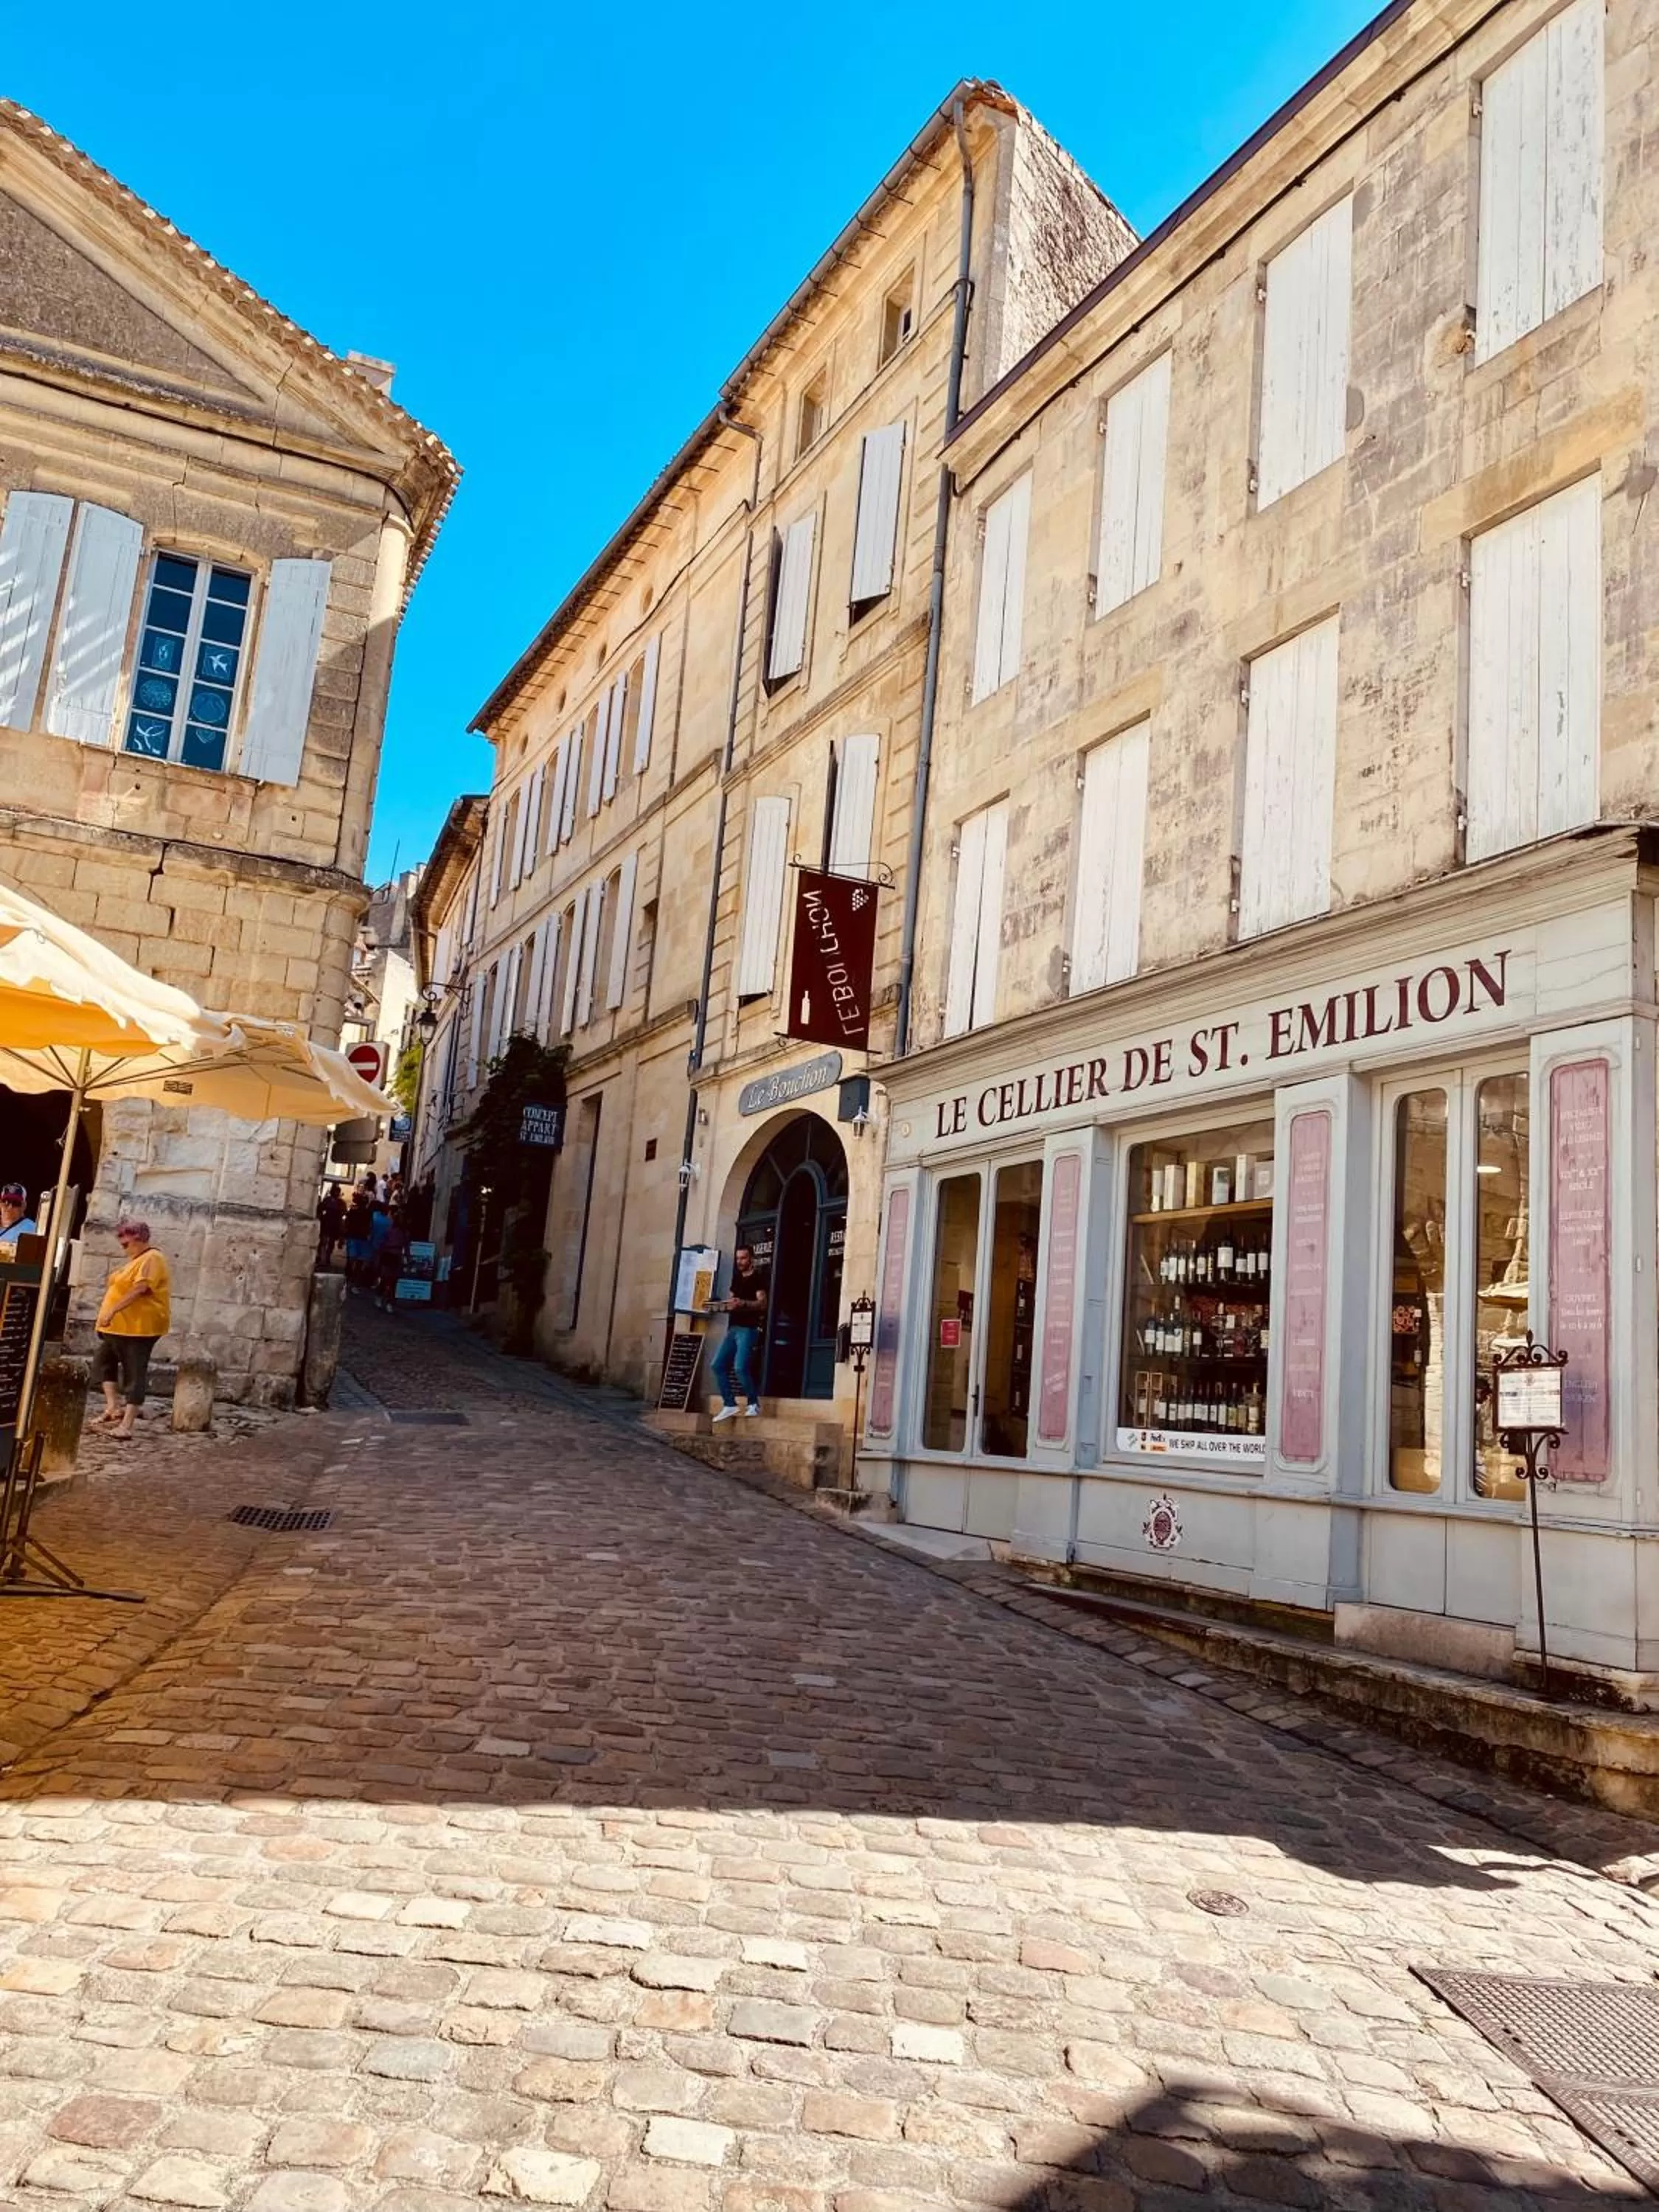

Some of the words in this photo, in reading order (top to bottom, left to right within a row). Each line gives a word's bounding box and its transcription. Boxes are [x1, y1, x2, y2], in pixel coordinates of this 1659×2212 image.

[936, 1099, 967, 1138] LE
[977, 1058, 1107, 1126] CELLIER
[1121, 1040, 1174, 1091] DE
[1189, 1022, 1248, 1078] ST.
[1267, 949, 1511, 1060] EMILION
[748, 1085, 765, 1109] Le
[768, 1063, 827, 1102] Bouchon
[1180, 1439, 1195, 1450] SHIP
[1197, 1441, 1208, 1451] ALL
[1208, 1441, 1227, 1452] OVER
[1228, 1442, 1241, 1453] THE
